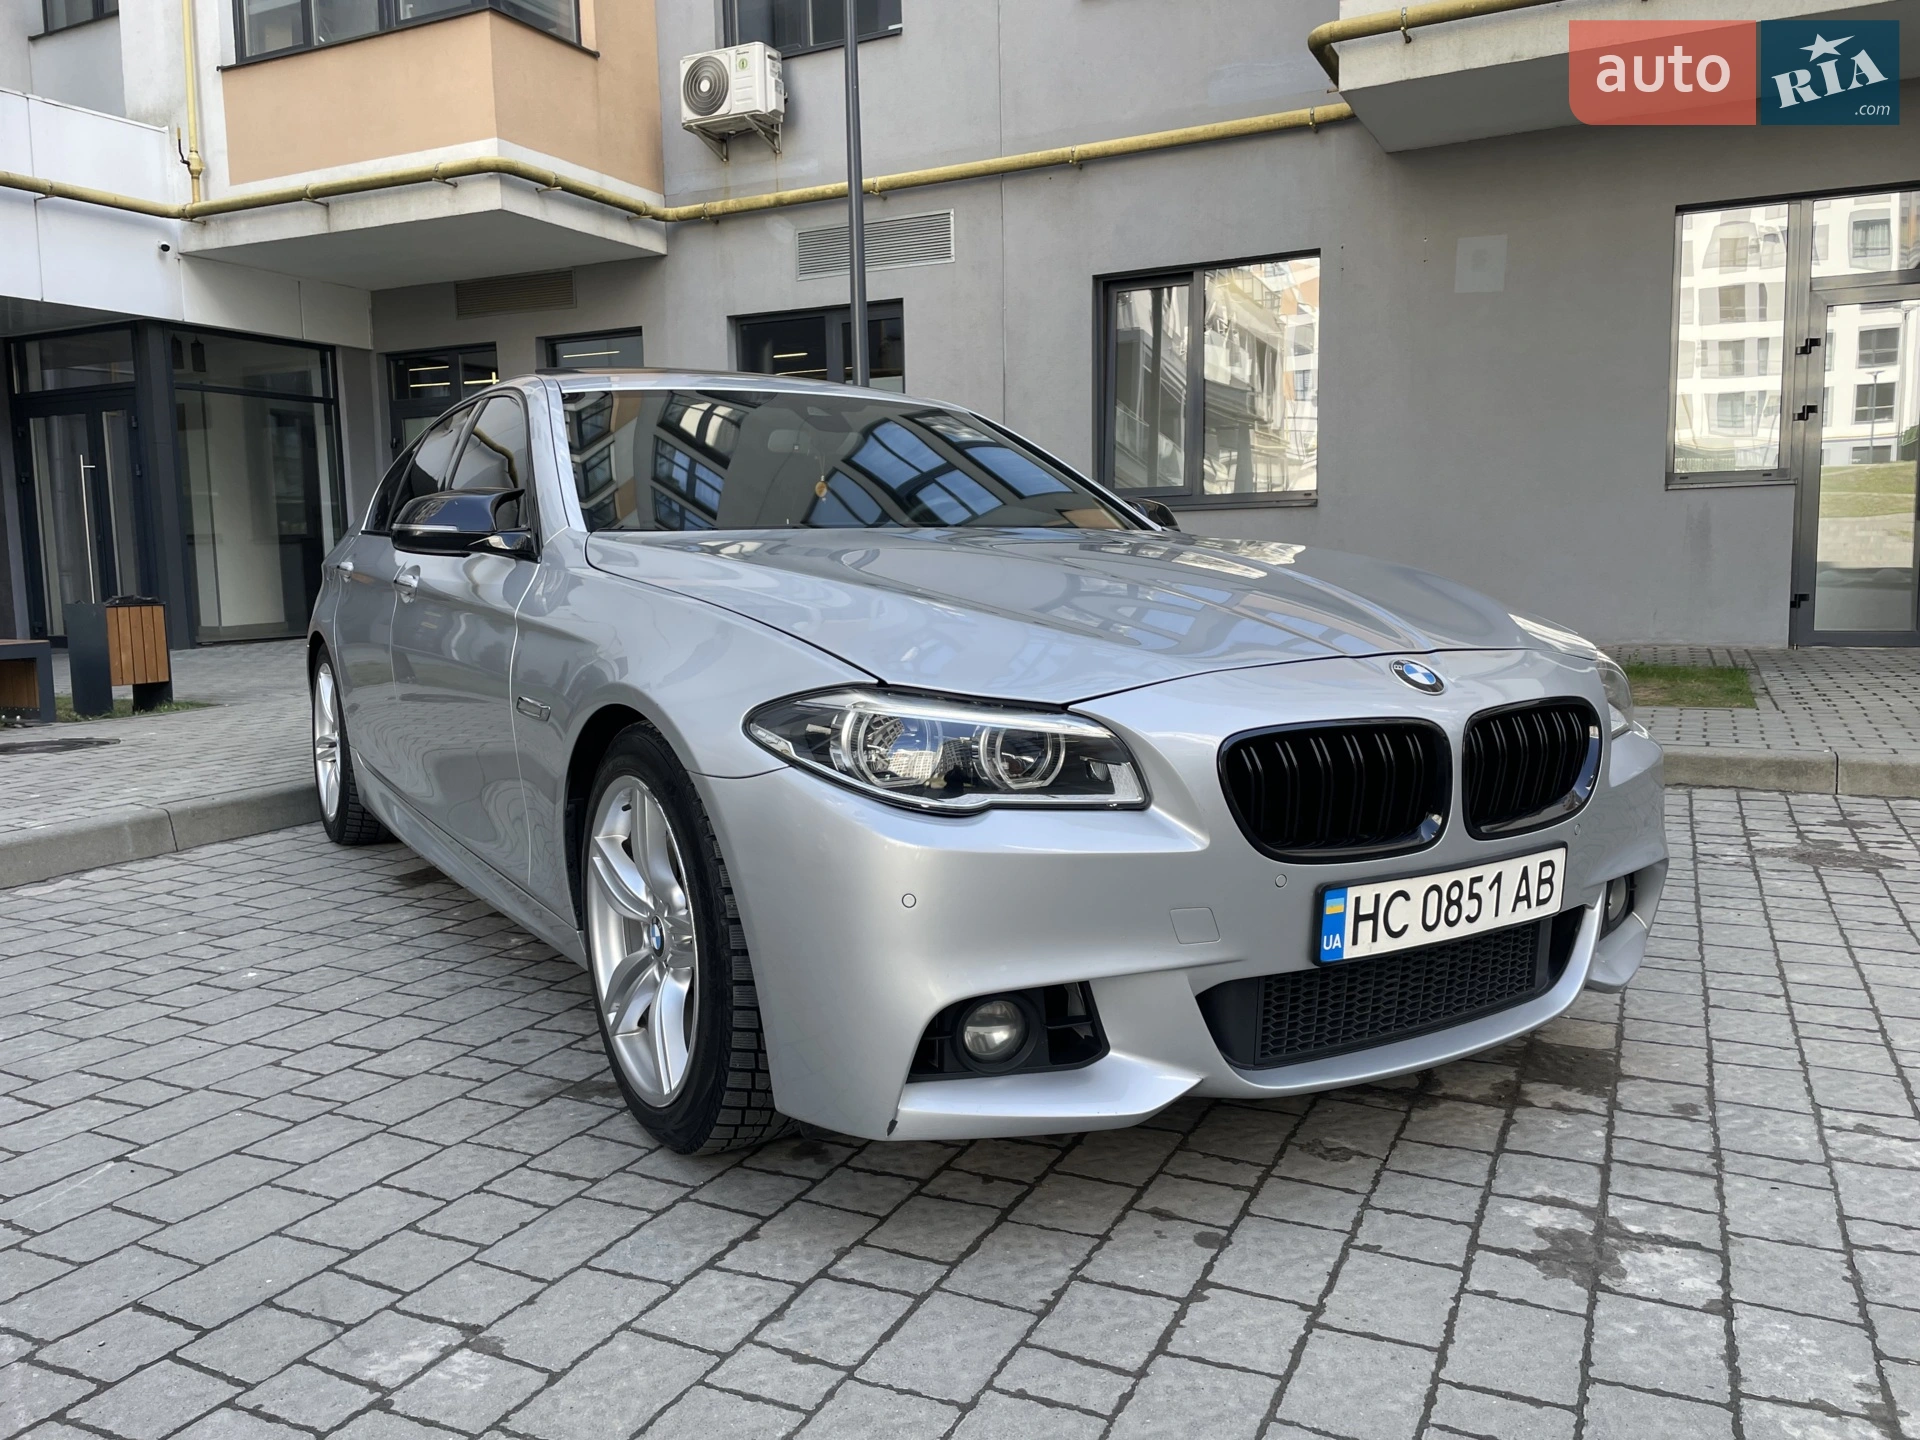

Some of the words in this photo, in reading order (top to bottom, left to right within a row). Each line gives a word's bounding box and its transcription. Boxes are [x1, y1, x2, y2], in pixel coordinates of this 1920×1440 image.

[1351, 890, 1411, 946] HC
[1421, 870, 1503, 932] 0851
[1511, 859, 1556, 914] AB
[1323, 933, 1342, 951] UA
